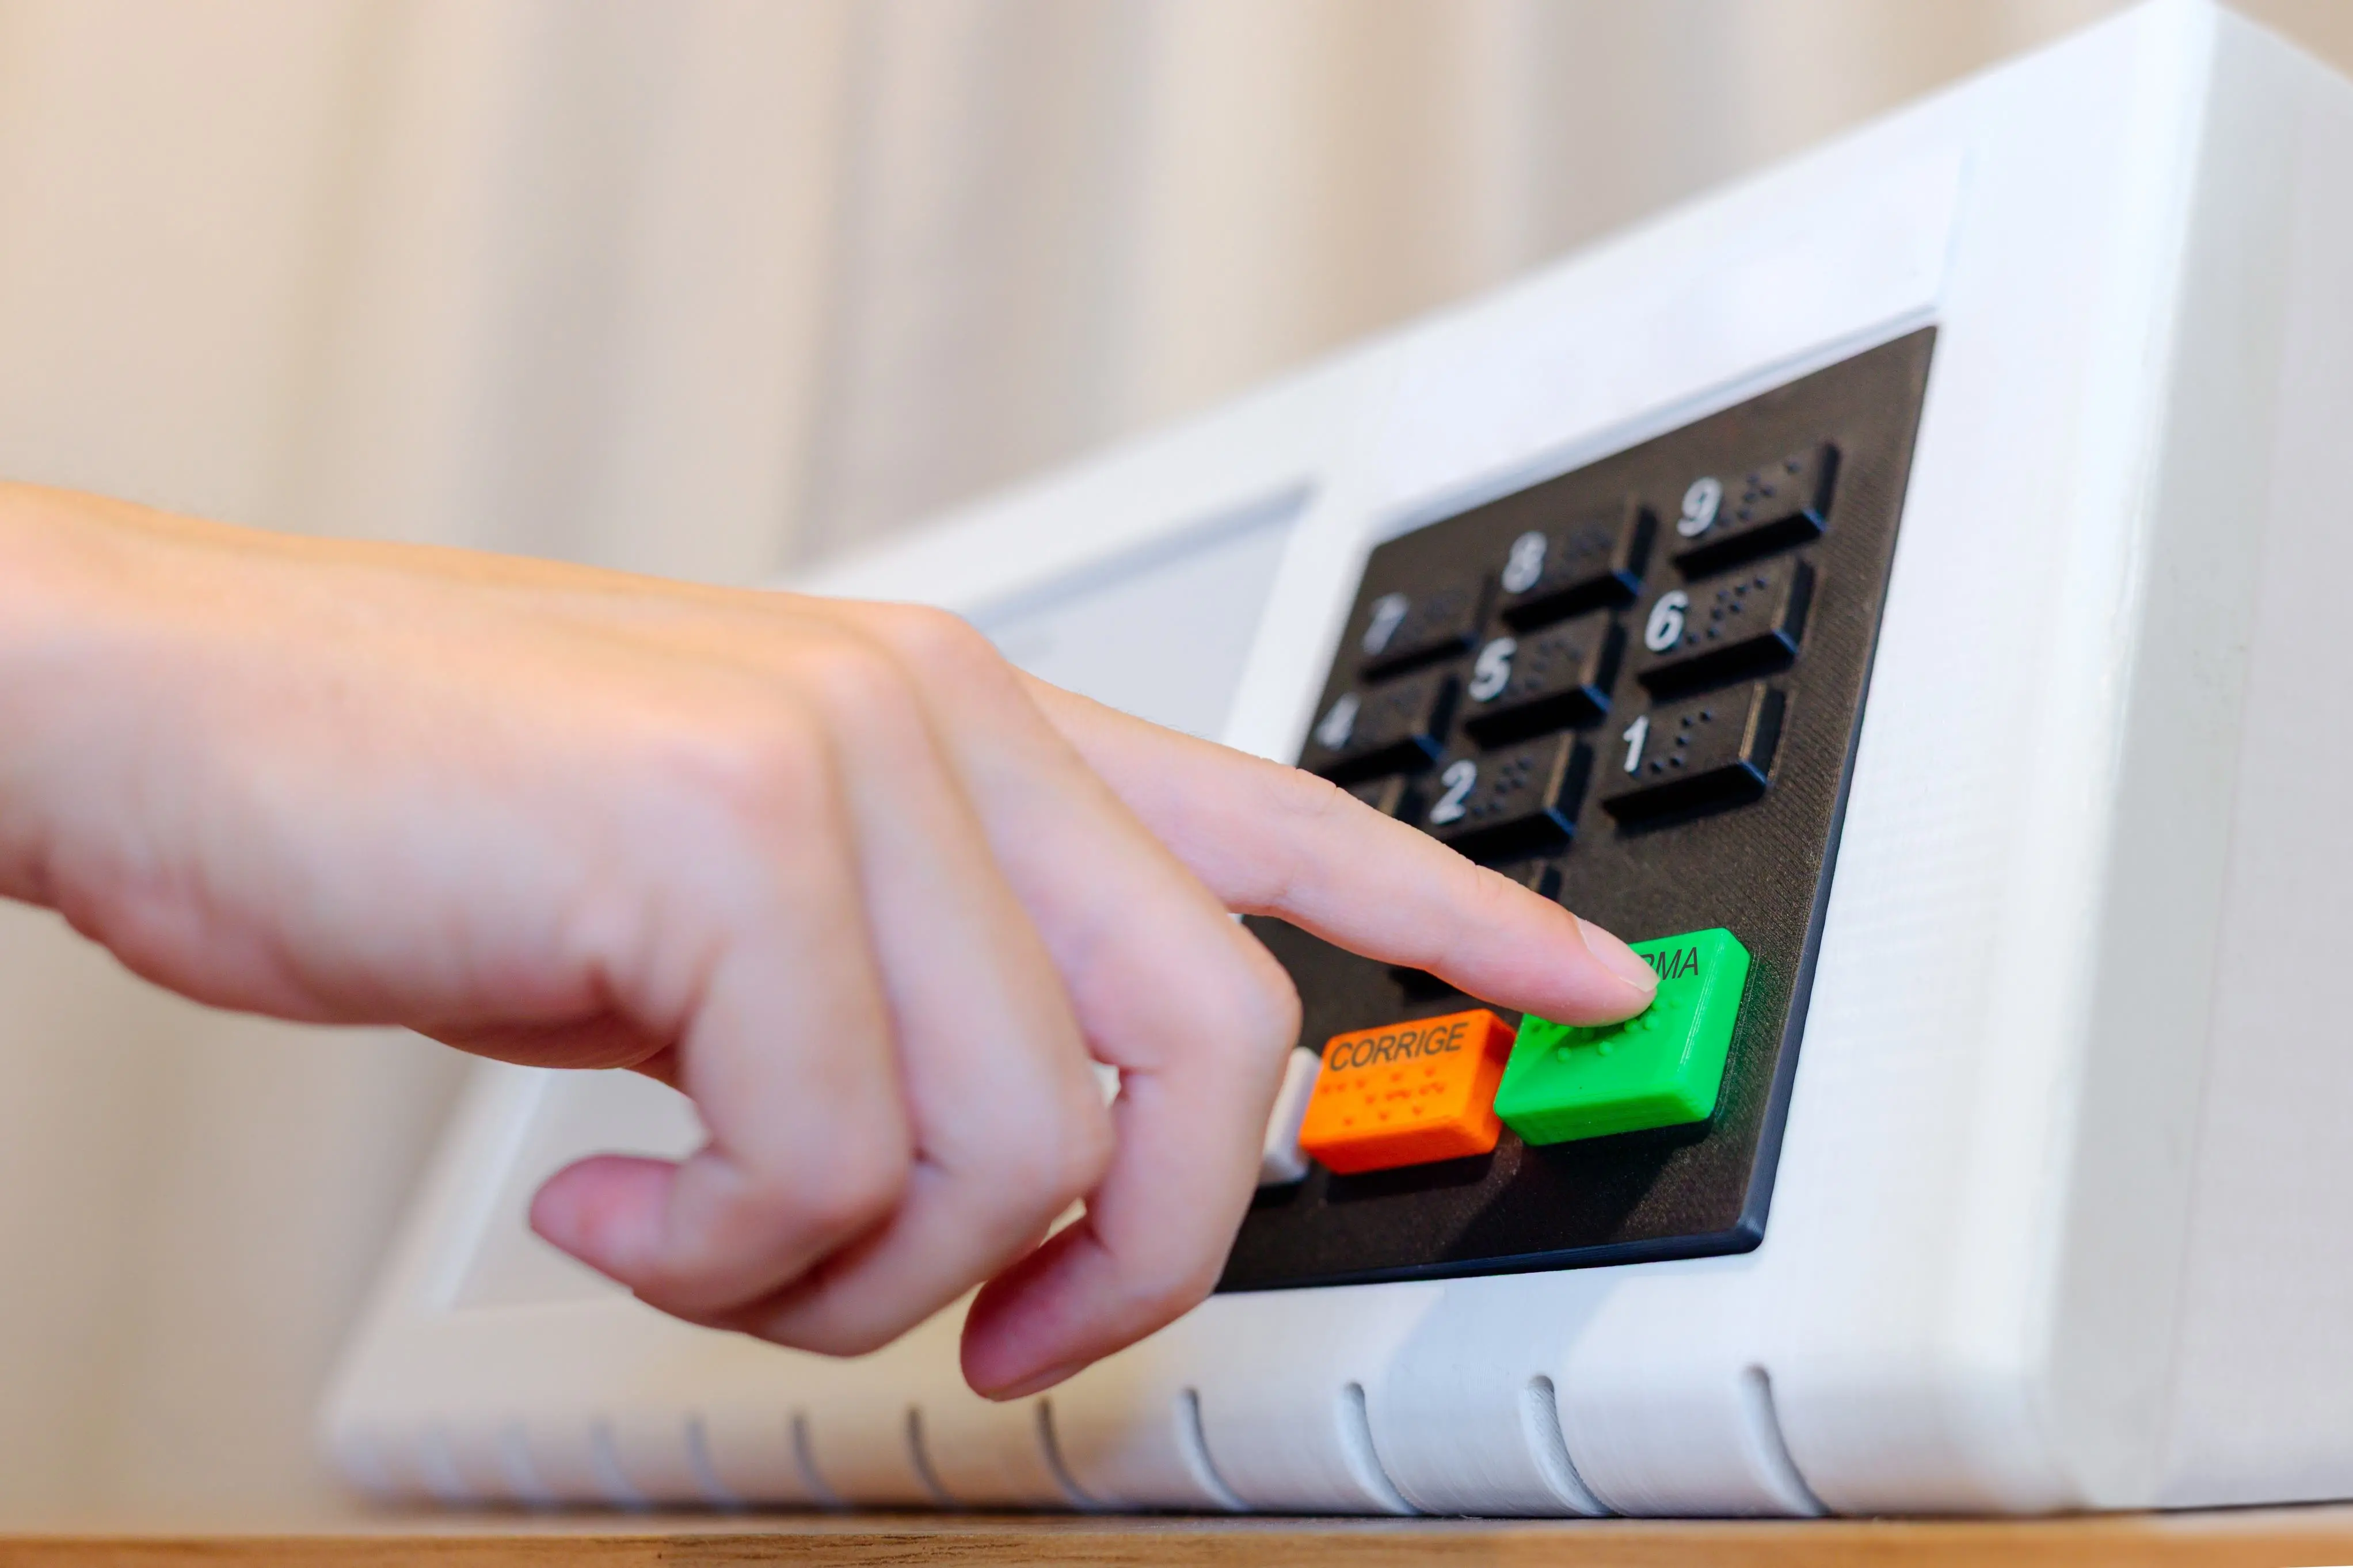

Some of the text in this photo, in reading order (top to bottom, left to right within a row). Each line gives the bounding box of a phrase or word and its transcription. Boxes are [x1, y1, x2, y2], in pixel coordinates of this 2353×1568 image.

[1678, 478, 1722, 536] 9
[1503, 532, 1547, 592] 8
[1645, 591, 1688, 650] 6
[1469, 638, 1517, 700] 5
[1624, 716, 1648, 772] 1
[1430, 760, 1477, 823] 2
[1330, 1022, 1469, 1071] CORRIGE
